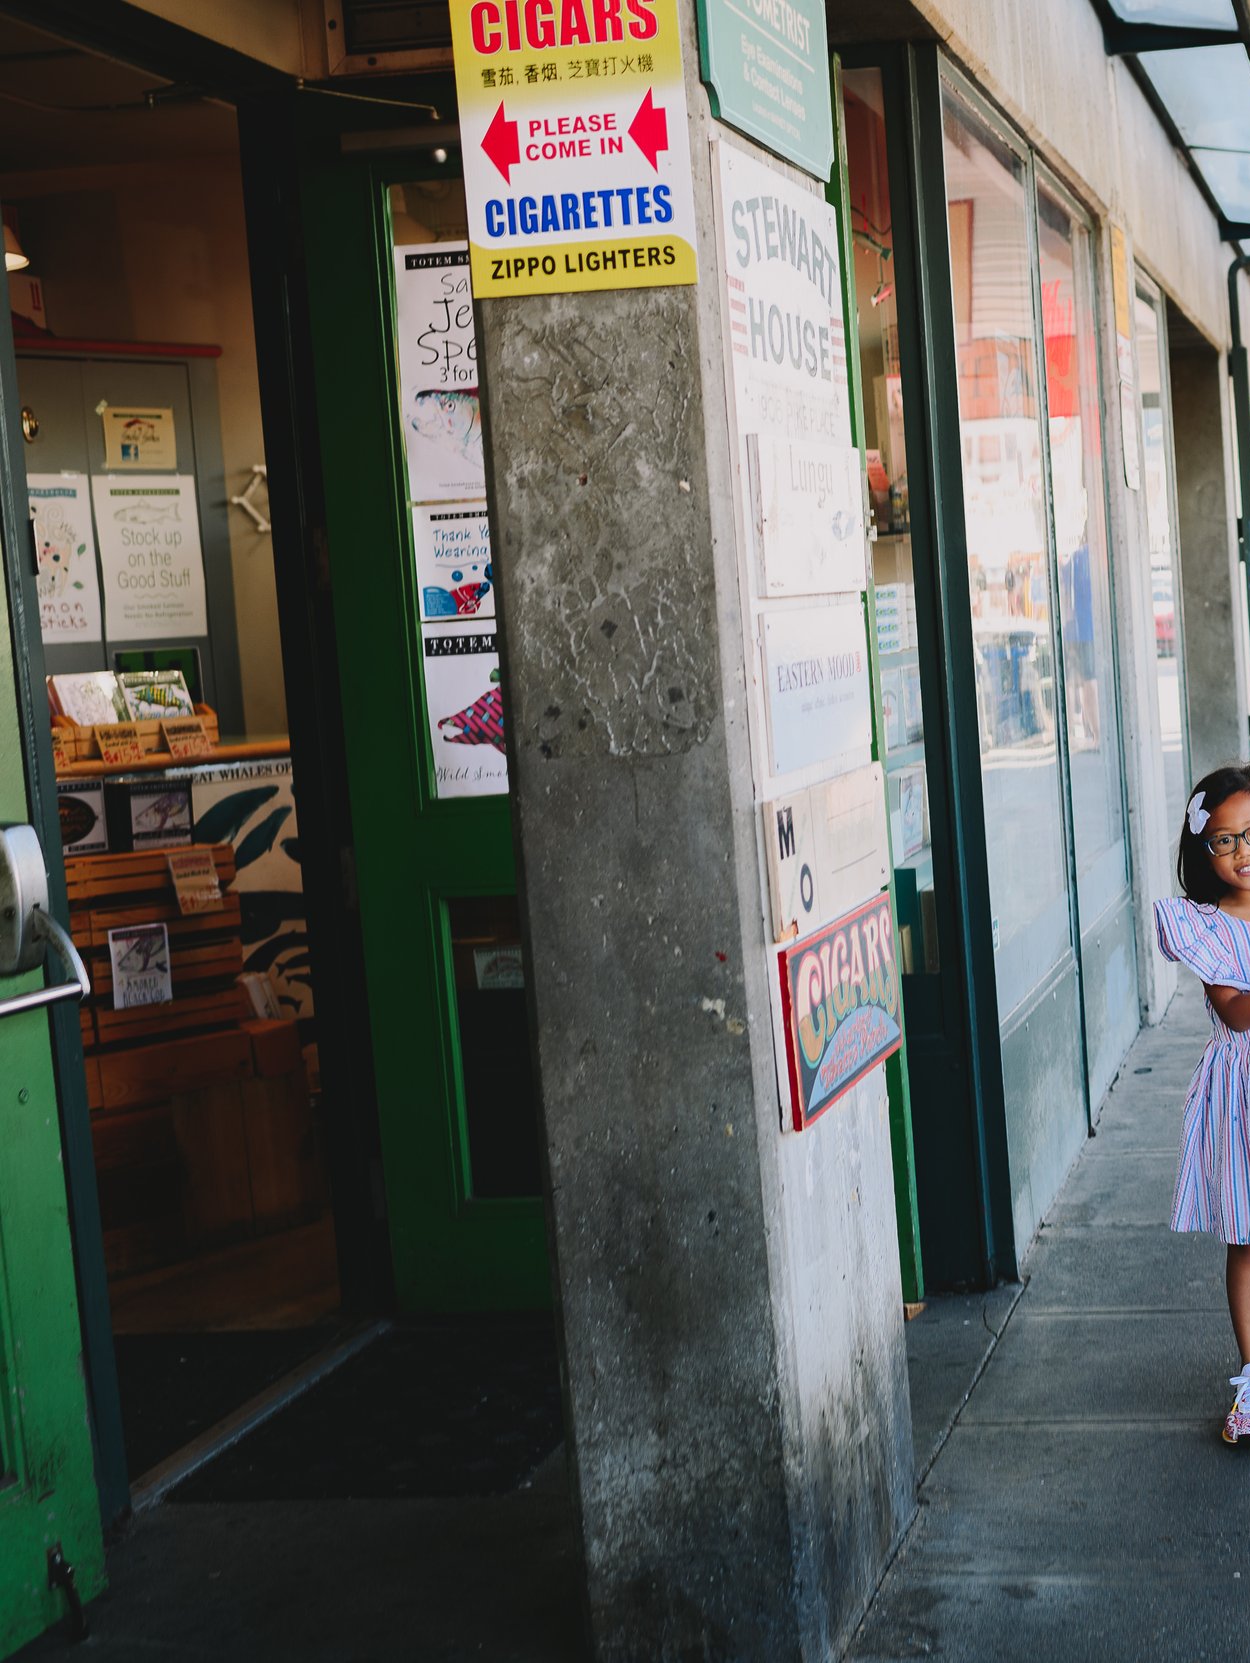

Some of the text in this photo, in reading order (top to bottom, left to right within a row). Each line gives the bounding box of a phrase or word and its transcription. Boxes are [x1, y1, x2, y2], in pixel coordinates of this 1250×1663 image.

[470, 0, 658, 54] CIGARS
[529, 113, 618, 138] PLEASE
[525, 136, 624, 161] COME IN
[485, 184, 673, 238] CIGARETTES
[411, 255, 452, 267] TOTEM
[491, 245, 677, 281] ZIPPO LIGHTERS
[731, 196, 836, 307] STEWART
[749, 297, 832, 381] HOUSE
[453, 366, 474, 383] for
[121, 527, 182, 548] Stock up
[433, 528, 471, 541] Thank
[128, 549, 172, 568] on the
[117, 568, 190, 589] Good Stuff
[430, 636, 492, 650] TOTEM
[777, 657, 824, 693] EASTERN
[828, 654, 855, 681] MOOD
[219, 765, 273, 780] WHALES
[796, 905, 899, 1069] CIGARS
